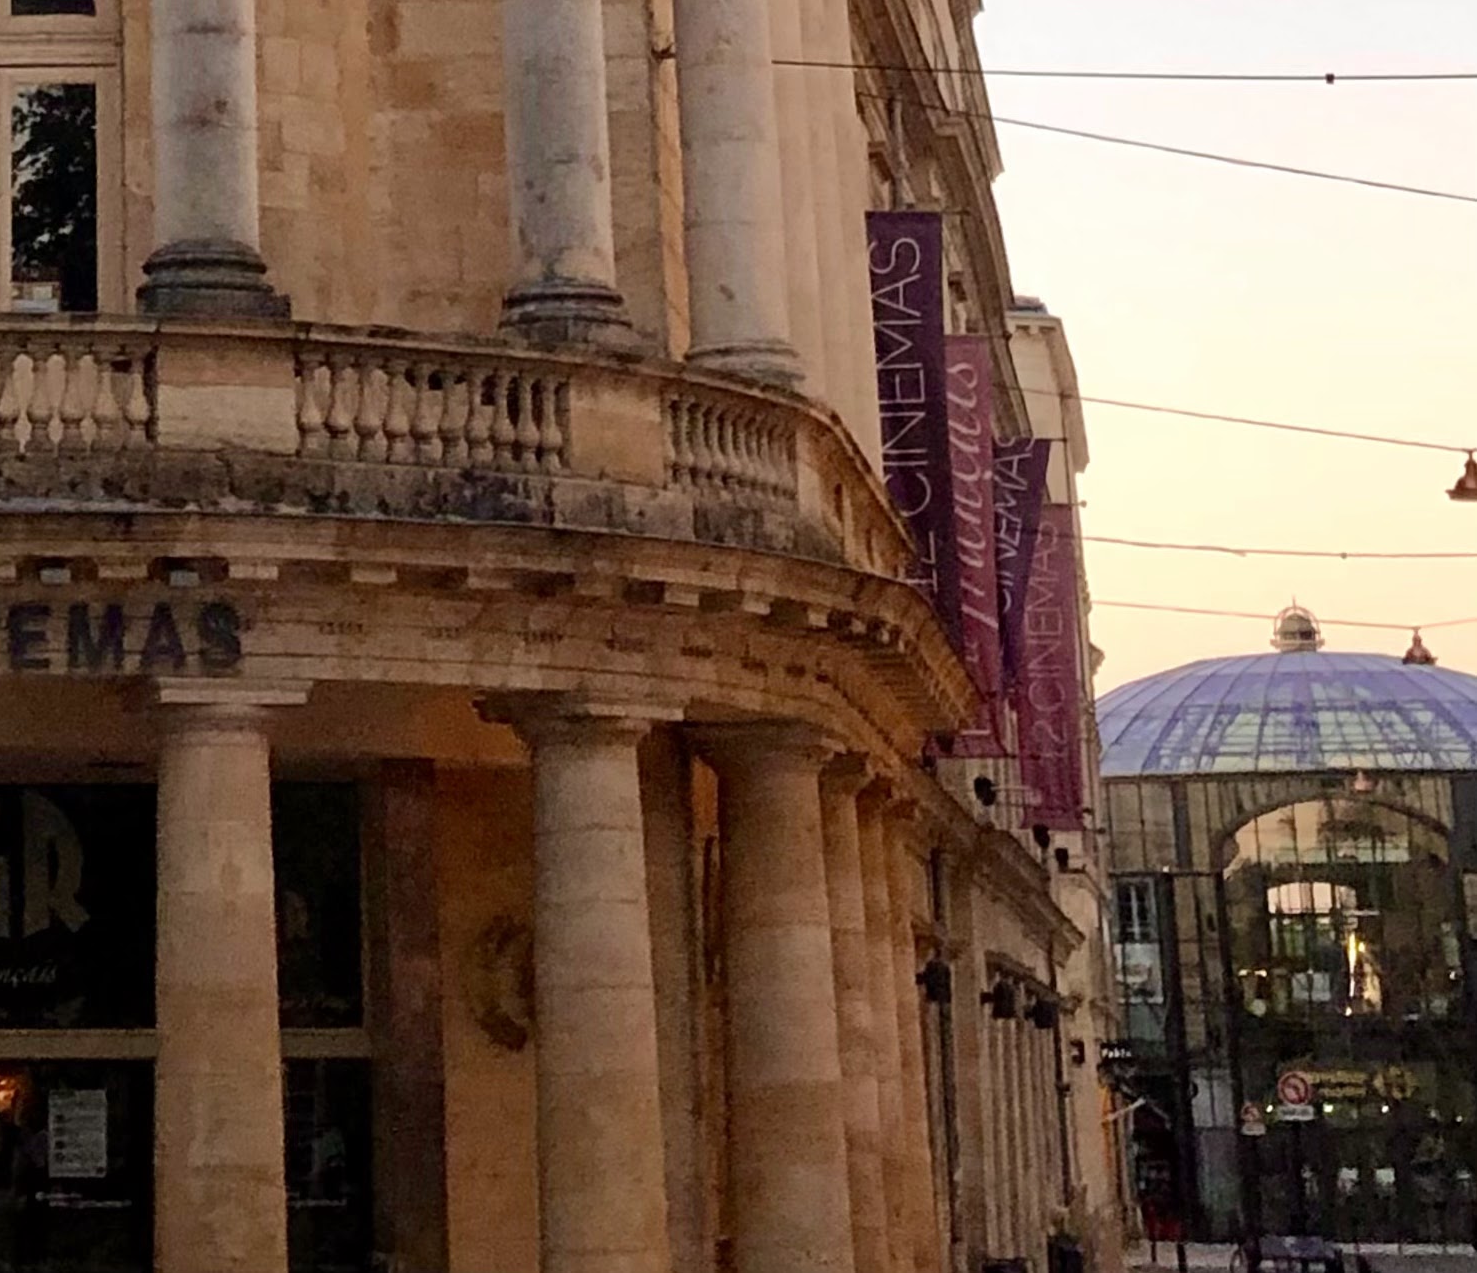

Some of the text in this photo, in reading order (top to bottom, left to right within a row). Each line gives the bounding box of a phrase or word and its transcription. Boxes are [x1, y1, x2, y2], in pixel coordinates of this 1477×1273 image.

[868, 236, 933, 517] CINEMAS
[994, 436, 1035, 613] NEMAS
[1024, 521, 1065, 712] CINEMAS
